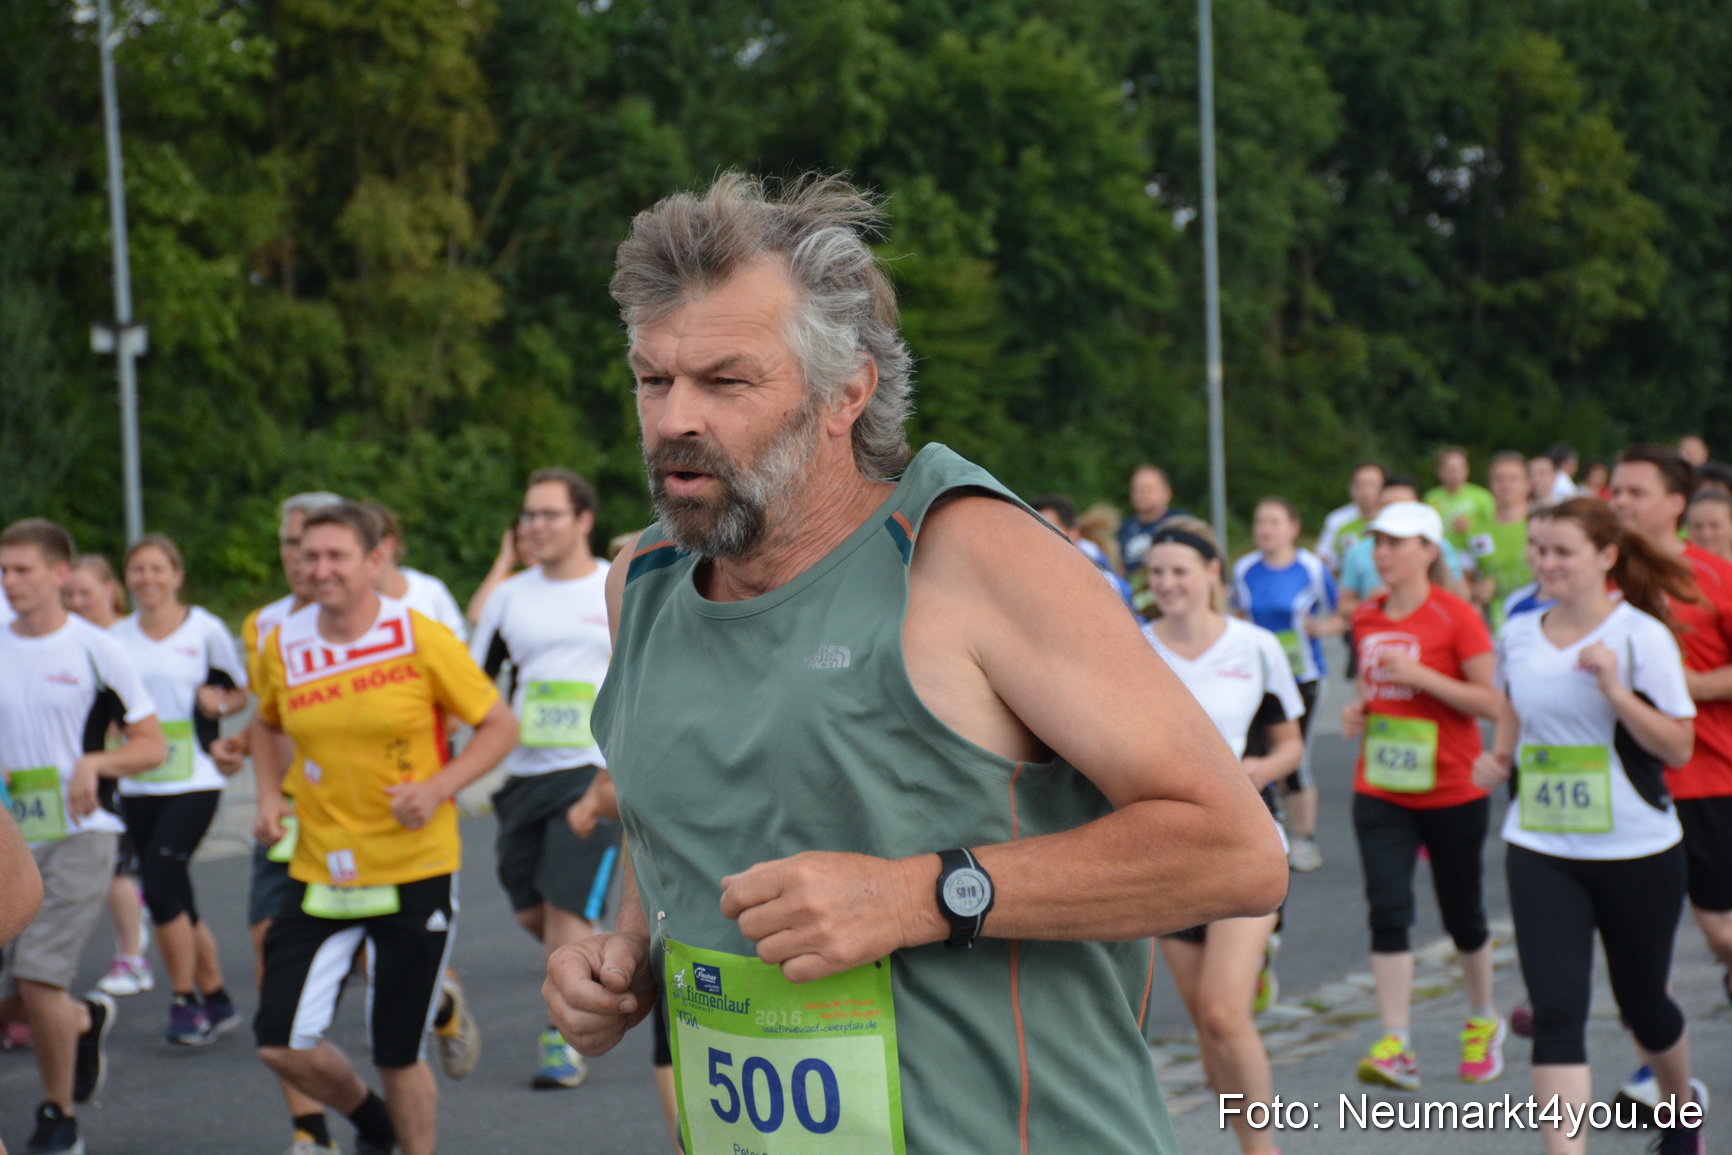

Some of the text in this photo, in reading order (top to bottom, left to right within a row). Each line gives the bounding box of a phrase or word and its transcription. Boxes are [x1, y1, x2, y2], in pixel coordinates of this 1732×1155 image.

[808, 660, 832, 669] FACE
[288, 664, 421, 713] MAX BÖGL
[1376, 746, 1419, 772] 428
[1535, 781, 1591, 809] 416
[687, 985, 750, 1015] firmenlauf
[755, 1010, 802, 1027] 2016
[708, 1046, 841, 1135] 500
